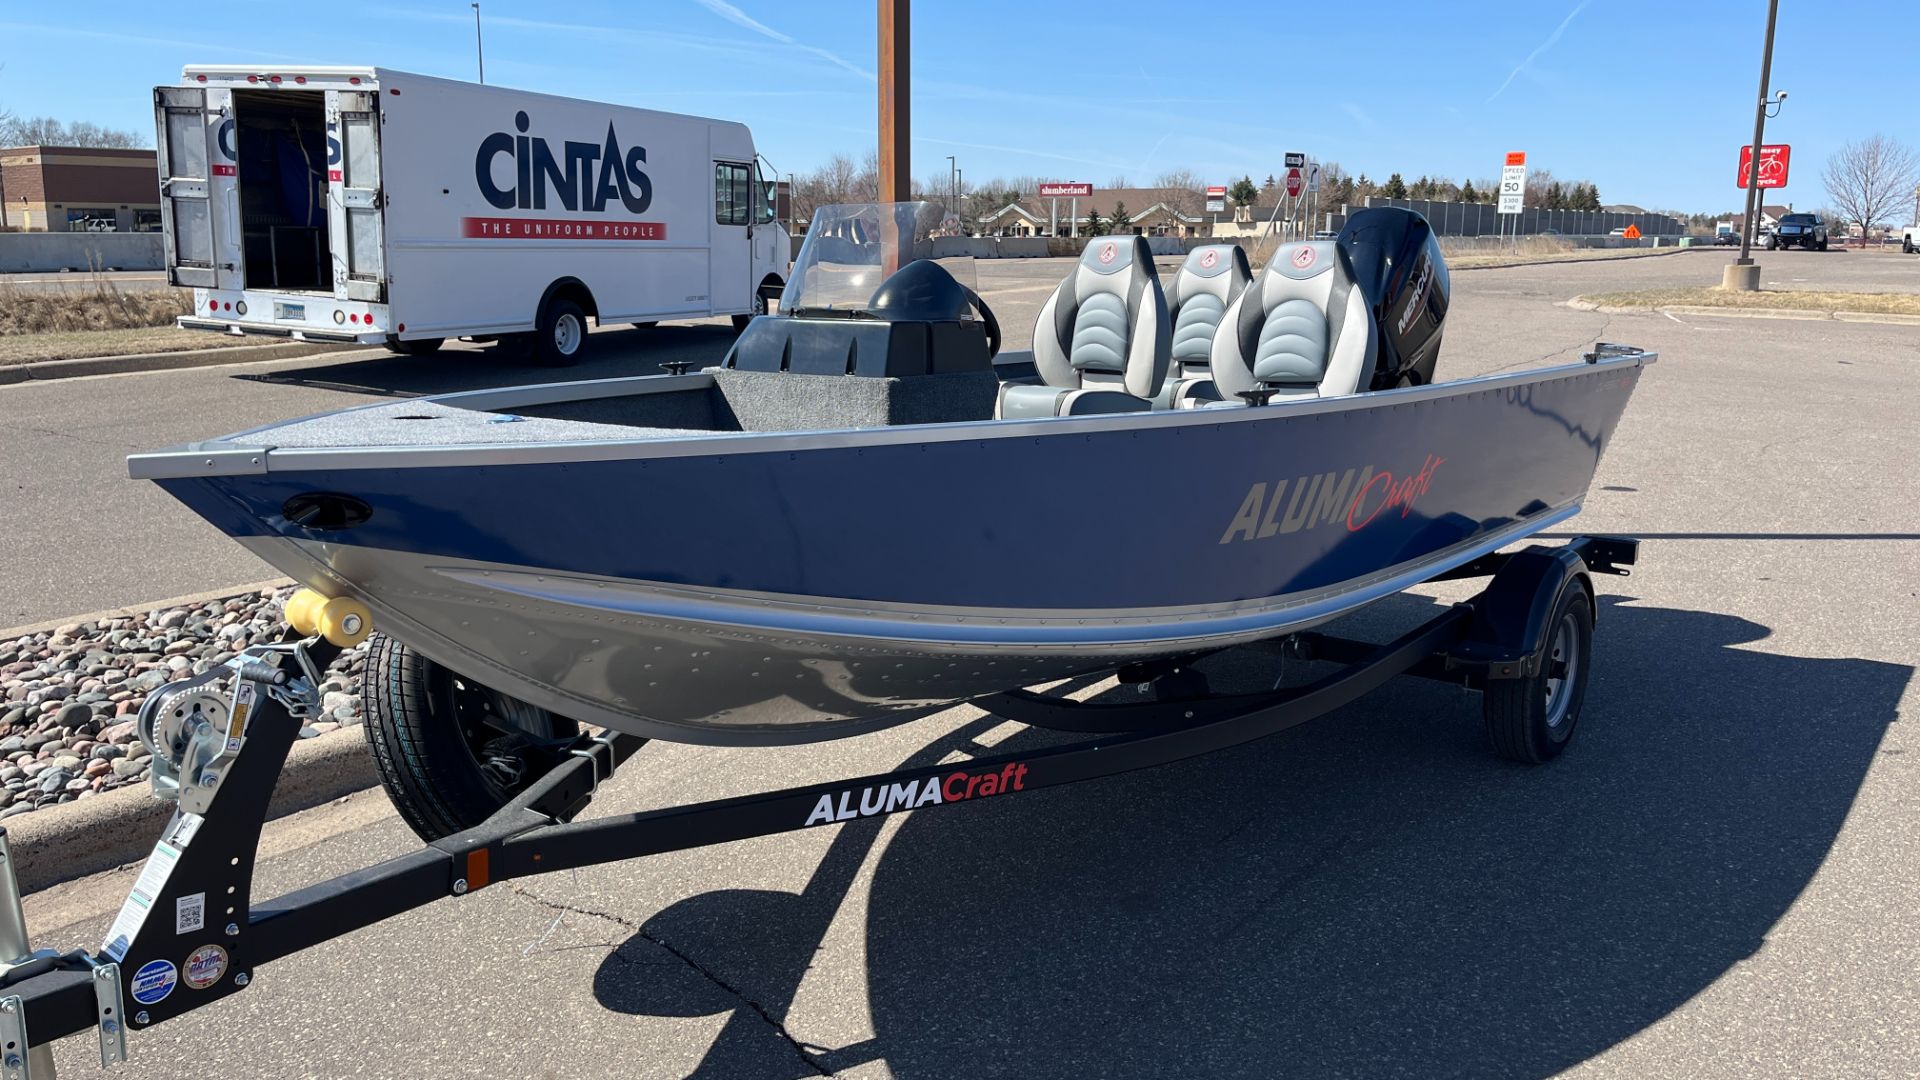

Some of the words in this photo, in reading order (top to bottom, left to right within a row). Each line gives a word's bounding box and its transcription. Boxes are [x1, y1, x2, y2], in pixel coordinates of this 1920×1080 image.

[1288, 177, 1300, 188] STOP
[1504, 182, 1519, 192] 50
[1041, 185, 1088, 194] slumberland
[481, 222, 511, 234] THE
[524, 223, 593, 235] UNIFORM
[604, 225, 654, 237] PEOPLE
